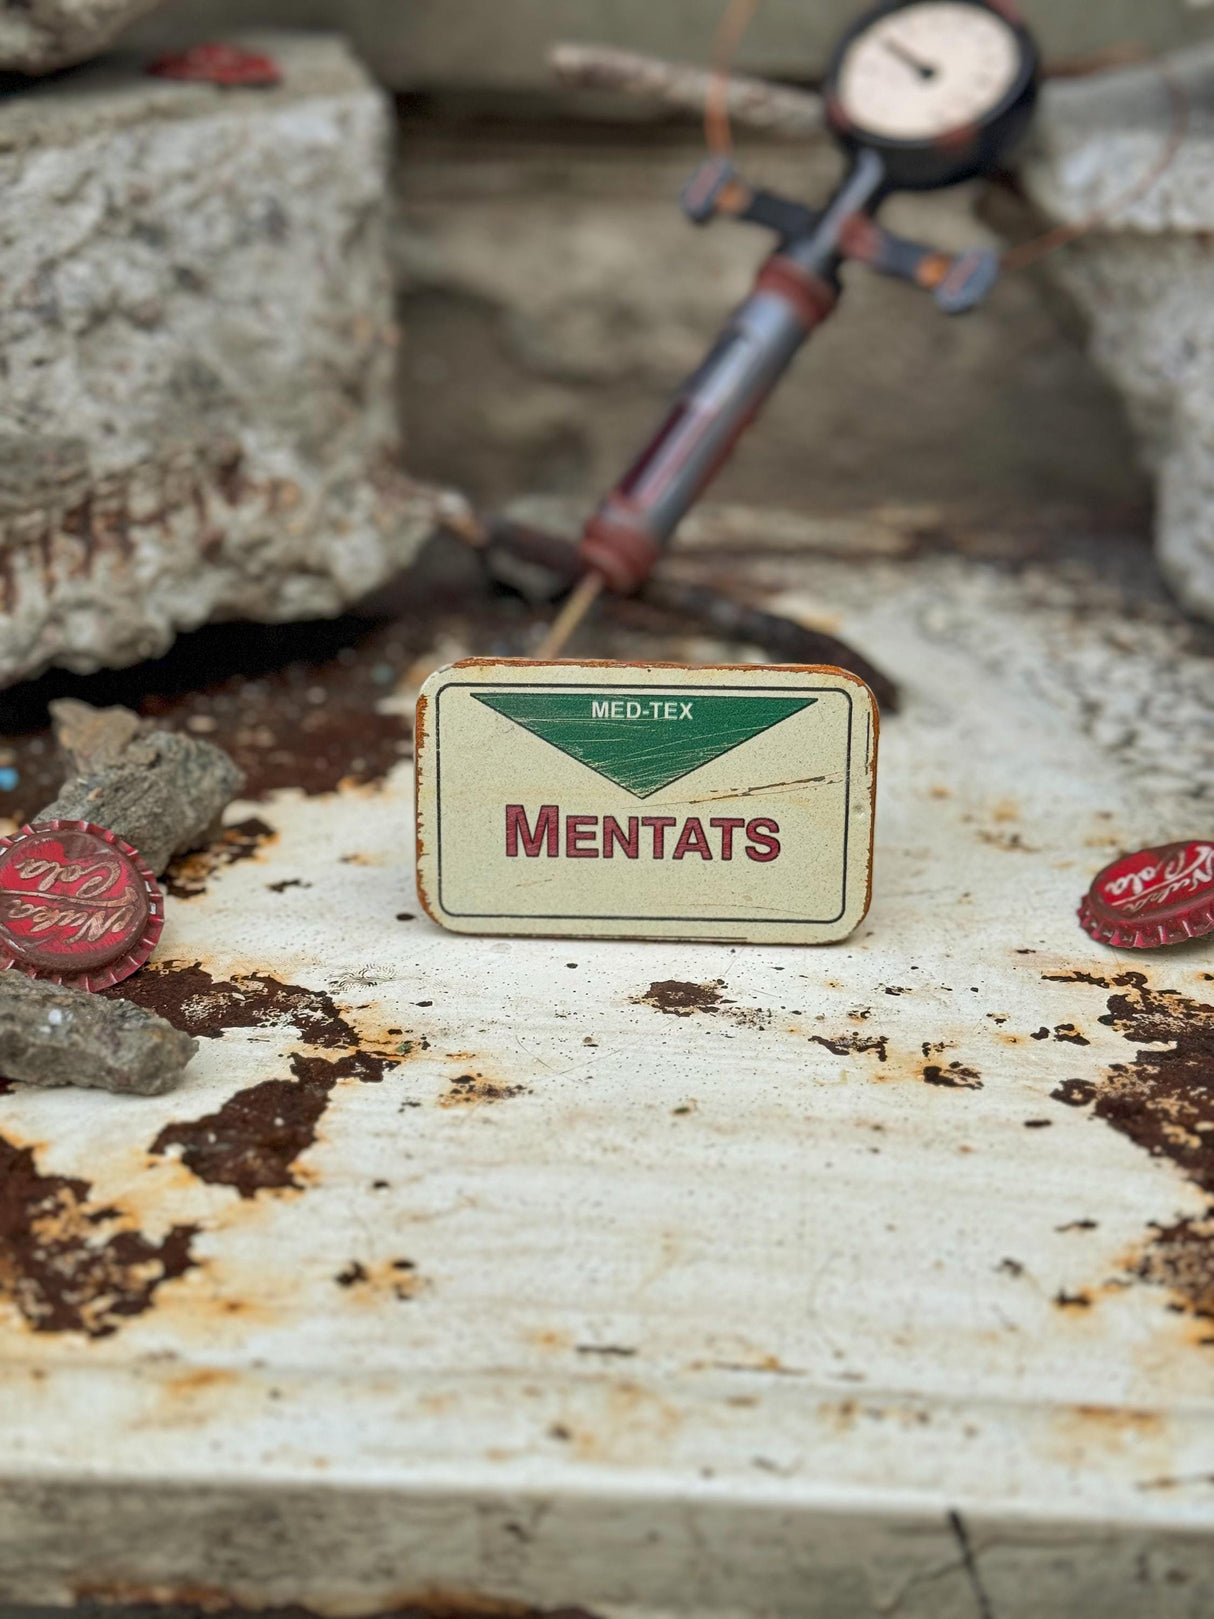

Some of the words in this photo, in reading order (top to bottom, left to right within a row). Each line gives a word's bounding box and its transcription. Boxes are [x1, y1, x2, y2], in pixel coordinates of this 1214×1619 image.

[591, 701, 694, 720] MED-TEX
[505, 804, 781, 863] MENTATS
[14, 858, 122, 899] Cola
[8, 900, 138, 945] Nuka
